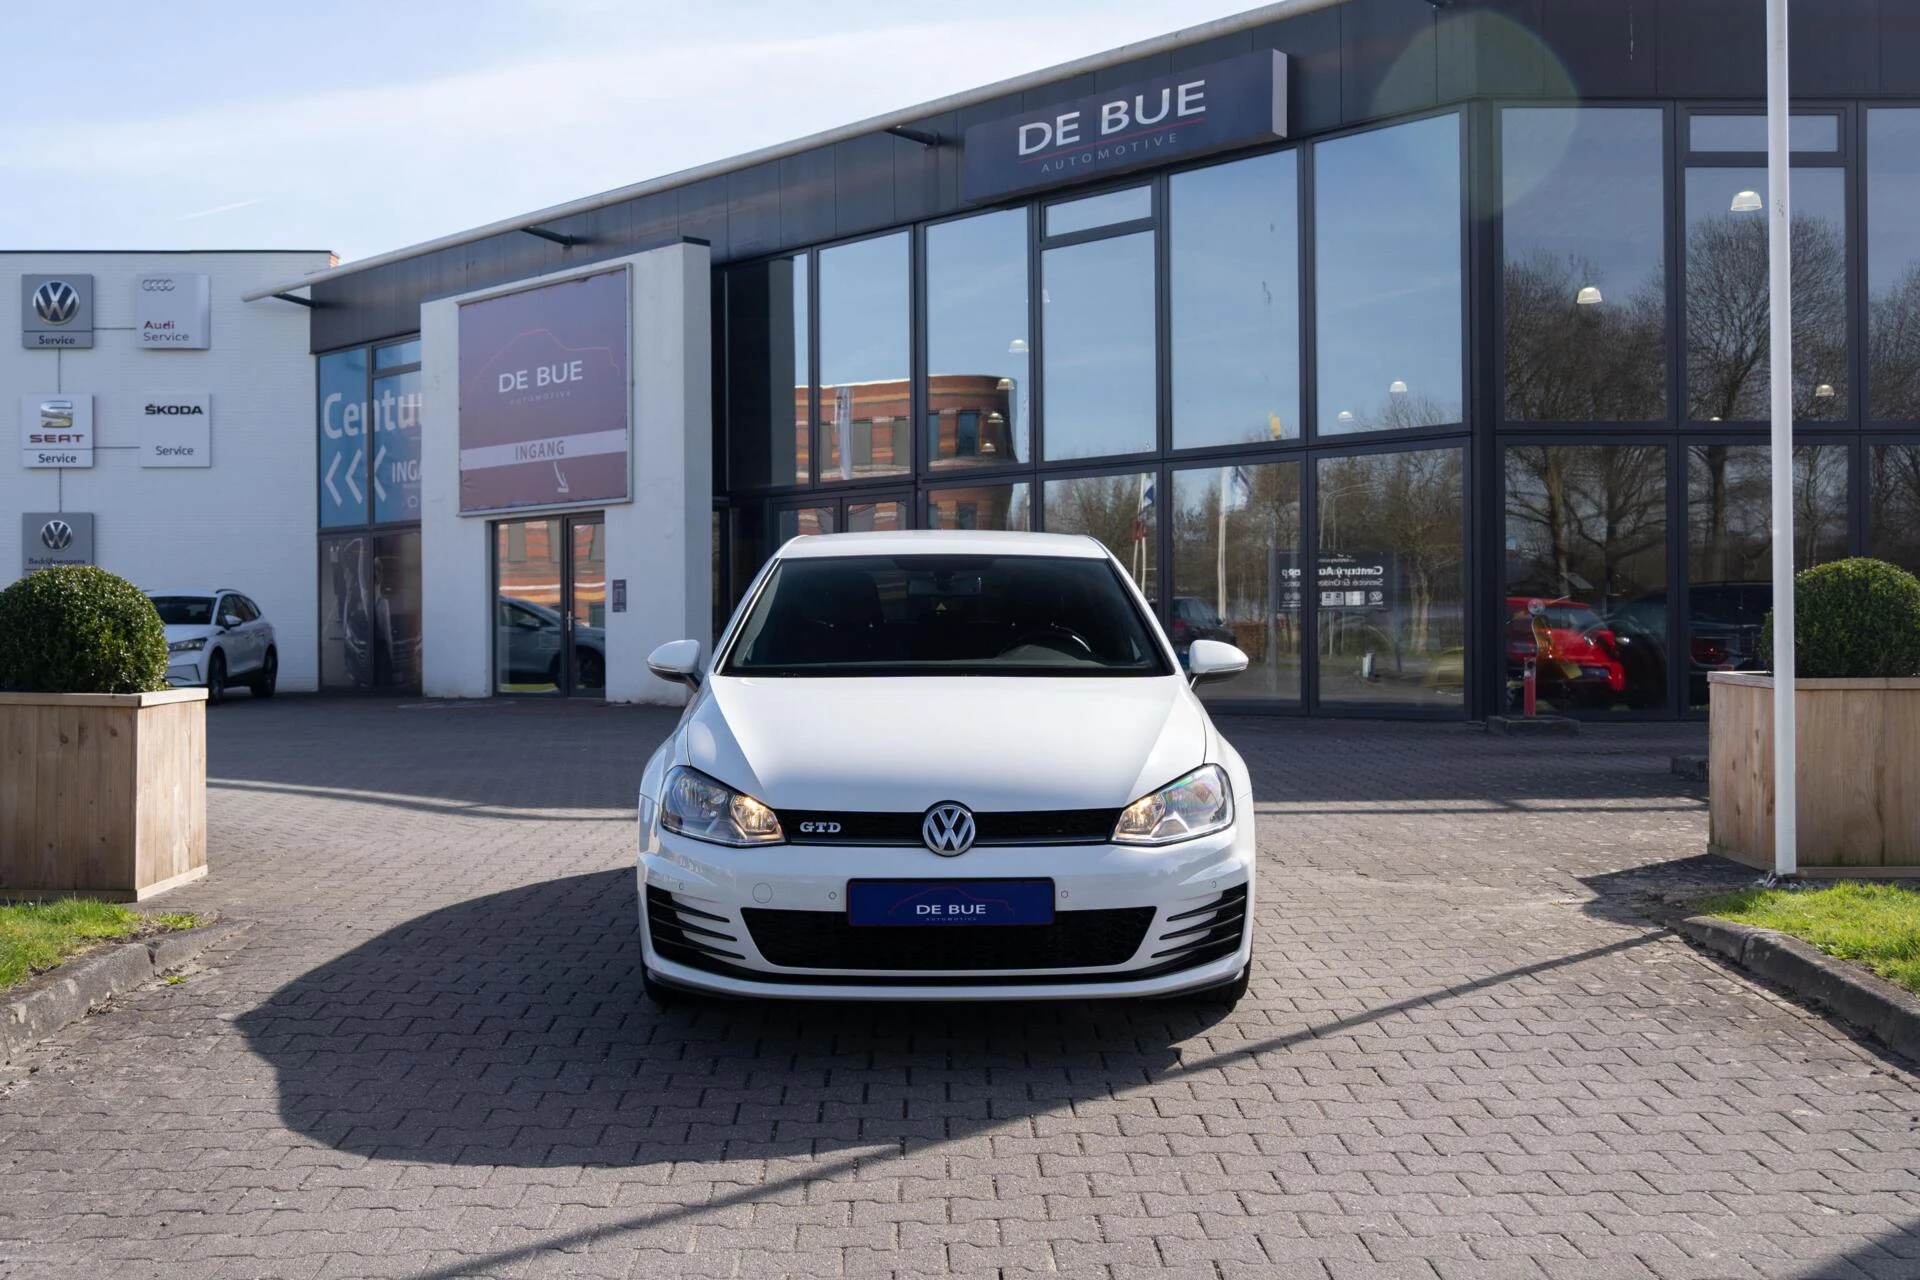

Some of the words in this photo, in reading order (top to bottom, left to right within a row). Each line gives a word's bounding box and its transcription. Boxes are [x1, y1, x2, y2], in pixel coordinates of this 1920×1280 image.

[1018, 111, 1081, 156] DE
[1101, 80, 1206, 135] BUE
[1041, 132, 1177, 173] AUTOMOTIVE
[144, 320, 175, 330] Audi
[38, 335, 76, 345] Service
[143, 332, 189, 342] Service
[498, 370, 528, 393] DE
[537, 360, 583, 387] BUE
[145, 403, 203, 415] ŠKODA
[29, 433, 84, 443] SEAT
[155, 445, 194, 456] Service
[515, 440, 565, 461] INGANG
[38, 453, 77, 464] Service
[800, 821, 842, 833] GTD
[916, 904, 942, 915] DE
[948, 904, 987, 915] BUE
